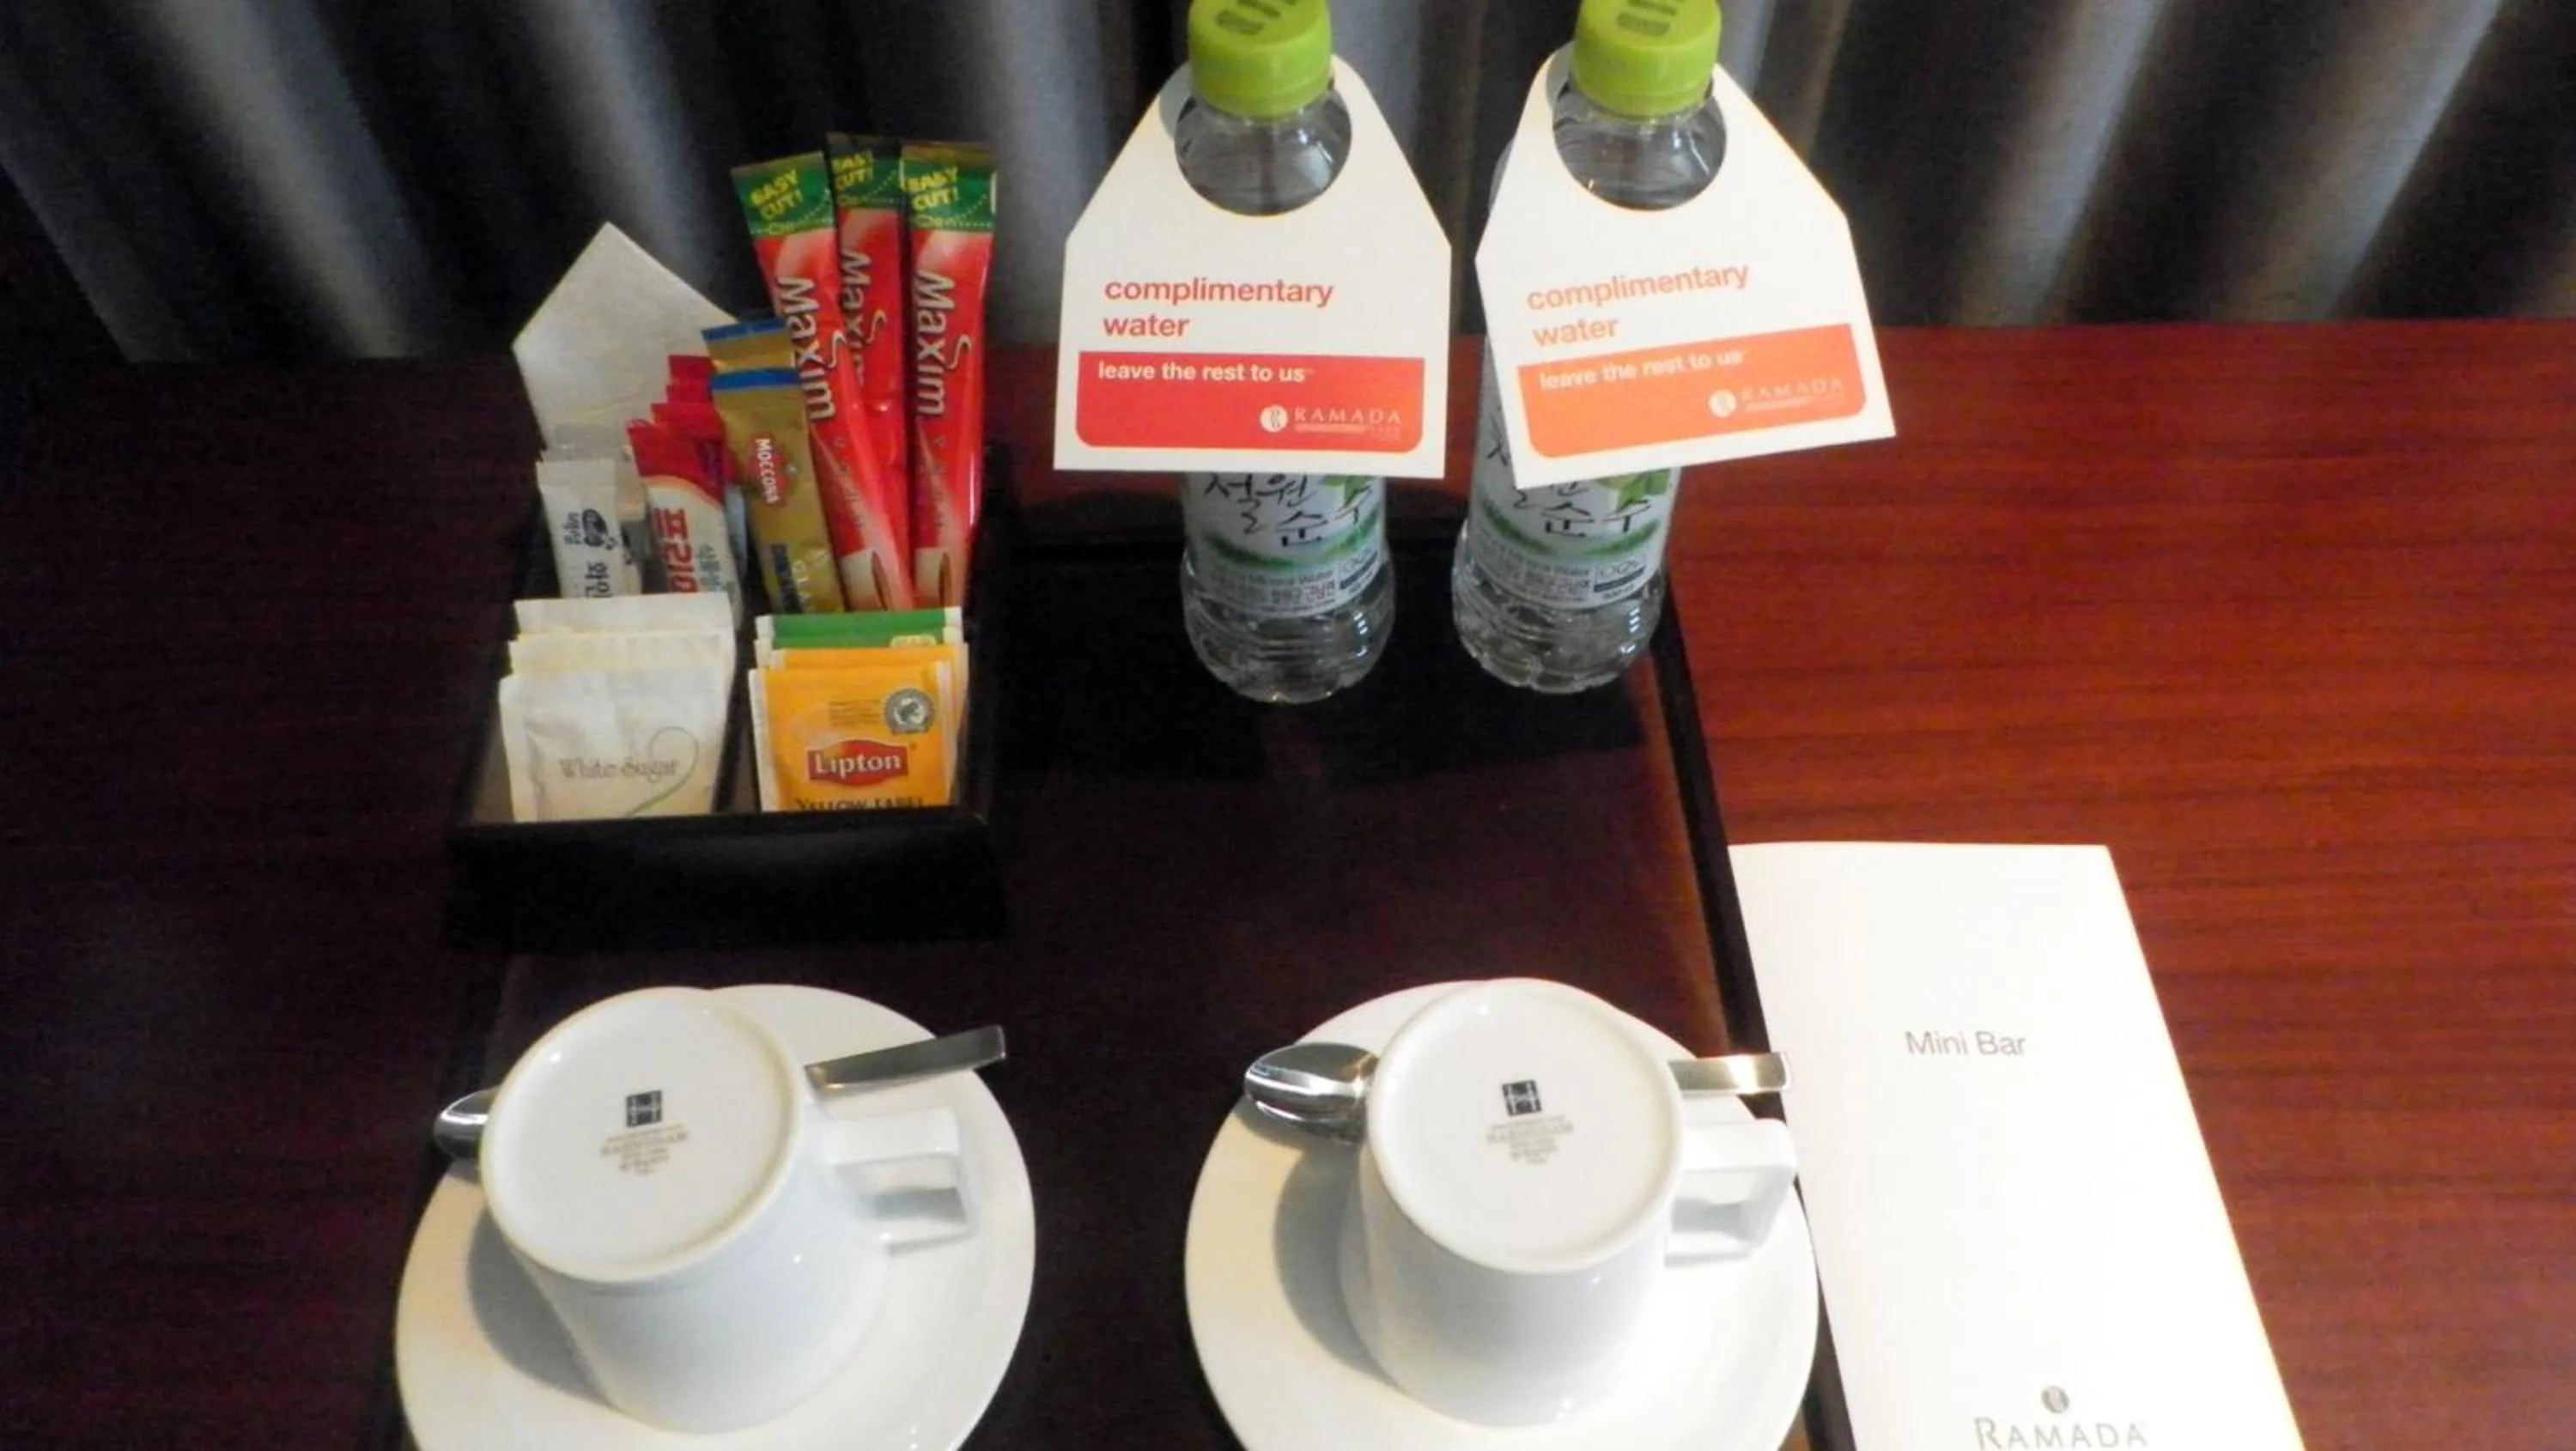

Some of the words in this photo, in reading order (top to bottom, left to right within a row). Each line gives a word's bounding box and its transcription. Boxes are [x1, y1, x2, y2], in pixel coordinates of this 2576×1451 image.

[1104, 276, 1334, 308] complimentary
[1527, 264, 1749, 311] complimentary
[1103, 313, 1190, 337] water
[1532, 317, 1619, 348] water
[776, 276, 835, 421] Maxim
[916, 269, 956, 416] Maxim
[1098, 361, 1155, 380] leave
[1162, 361, 1197, 381] the
[1203, 364, 1245, 382] rest
[1251, 364, 1273, 383] to
[1279, 367, 1306, 384] us
[1540, 369, 1596, 392] leave
[1602, 361, 1637, 383] the
[1643, 355, 1686, 376] rest
[1690, 351, 1711, 371] to
[1294, 405, 1402, 425] RAMADA
[755, 438, 781, 505] MOCCONA
[814, 752, 902, 780] Lipton
[1905, 1029, 1969, 1056] Mini
[1975, 1029, 2026, 1056] Bar
[1973, 1416, 2149, 1450] RAMADA
